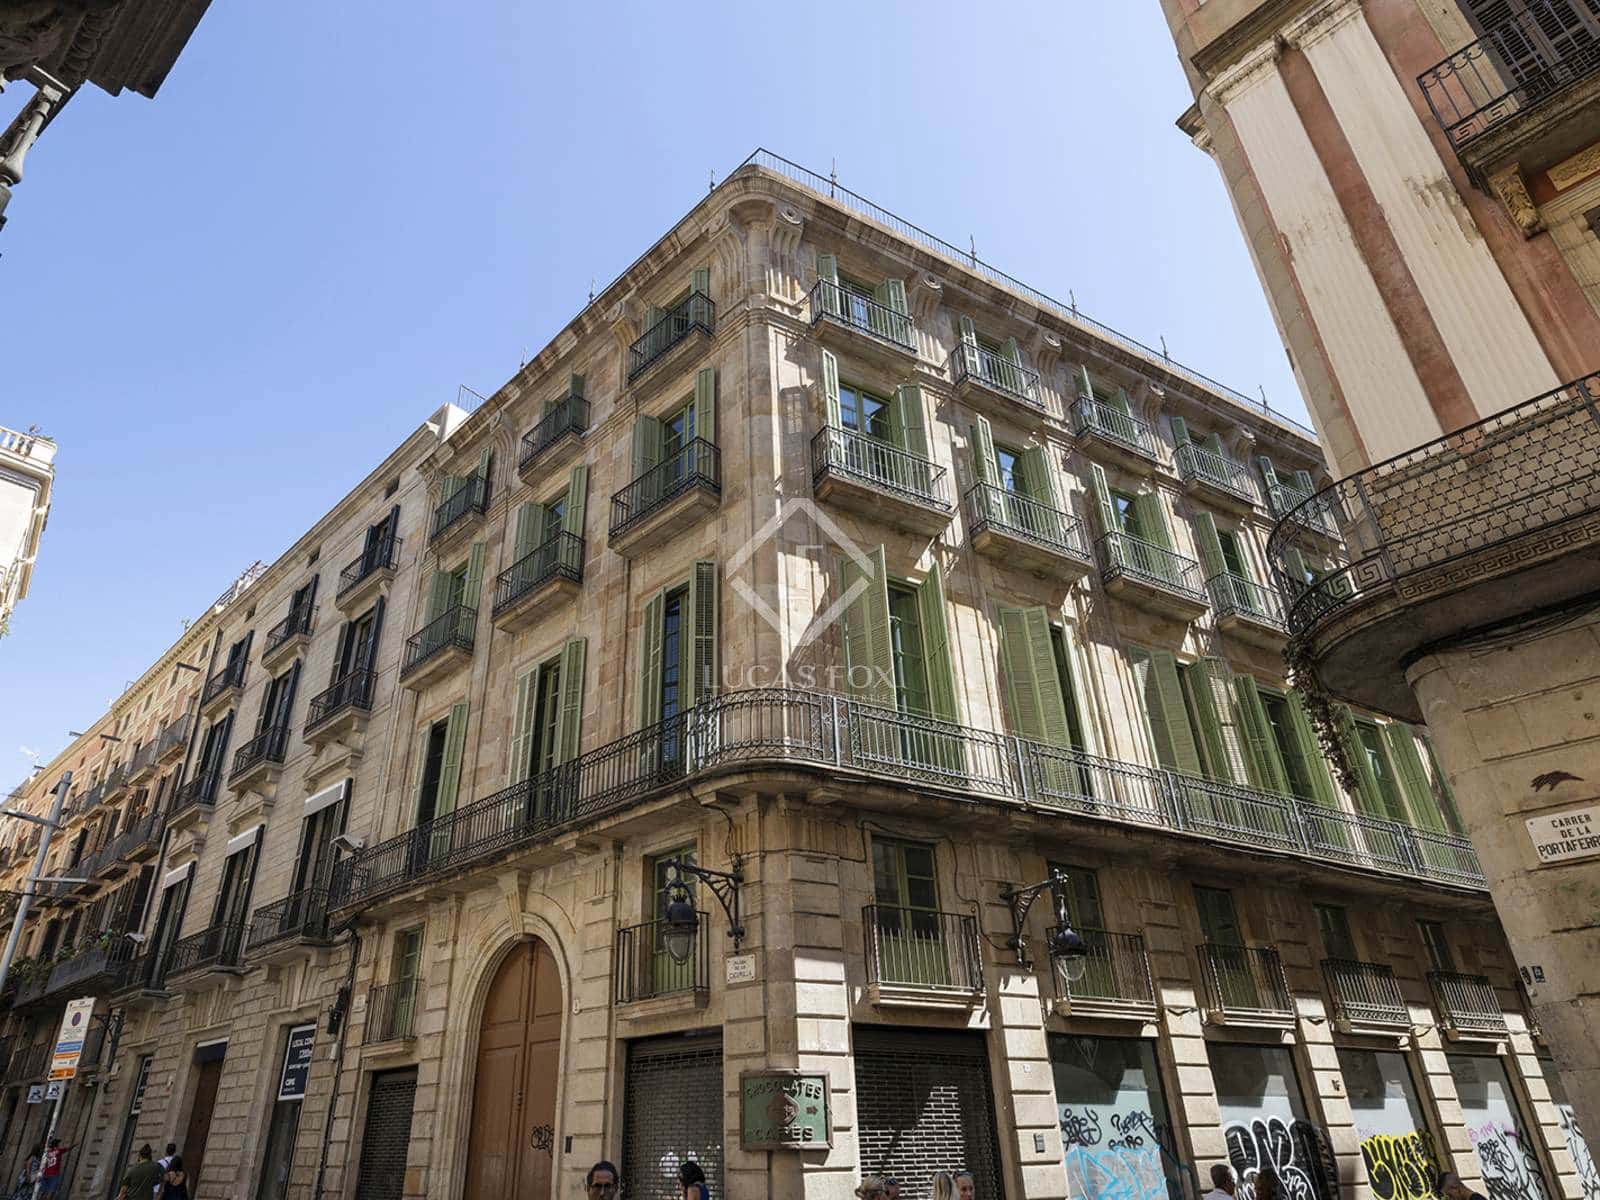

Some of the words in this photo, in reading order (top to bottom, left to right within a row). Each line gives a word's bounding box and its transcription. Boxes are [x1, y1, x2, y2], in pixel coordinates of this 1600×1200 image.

[1551, 814, 1592, 828] CARRER
[1560, 829, 1575, 838] DE
[1577, 825, 1591, 836] LA
